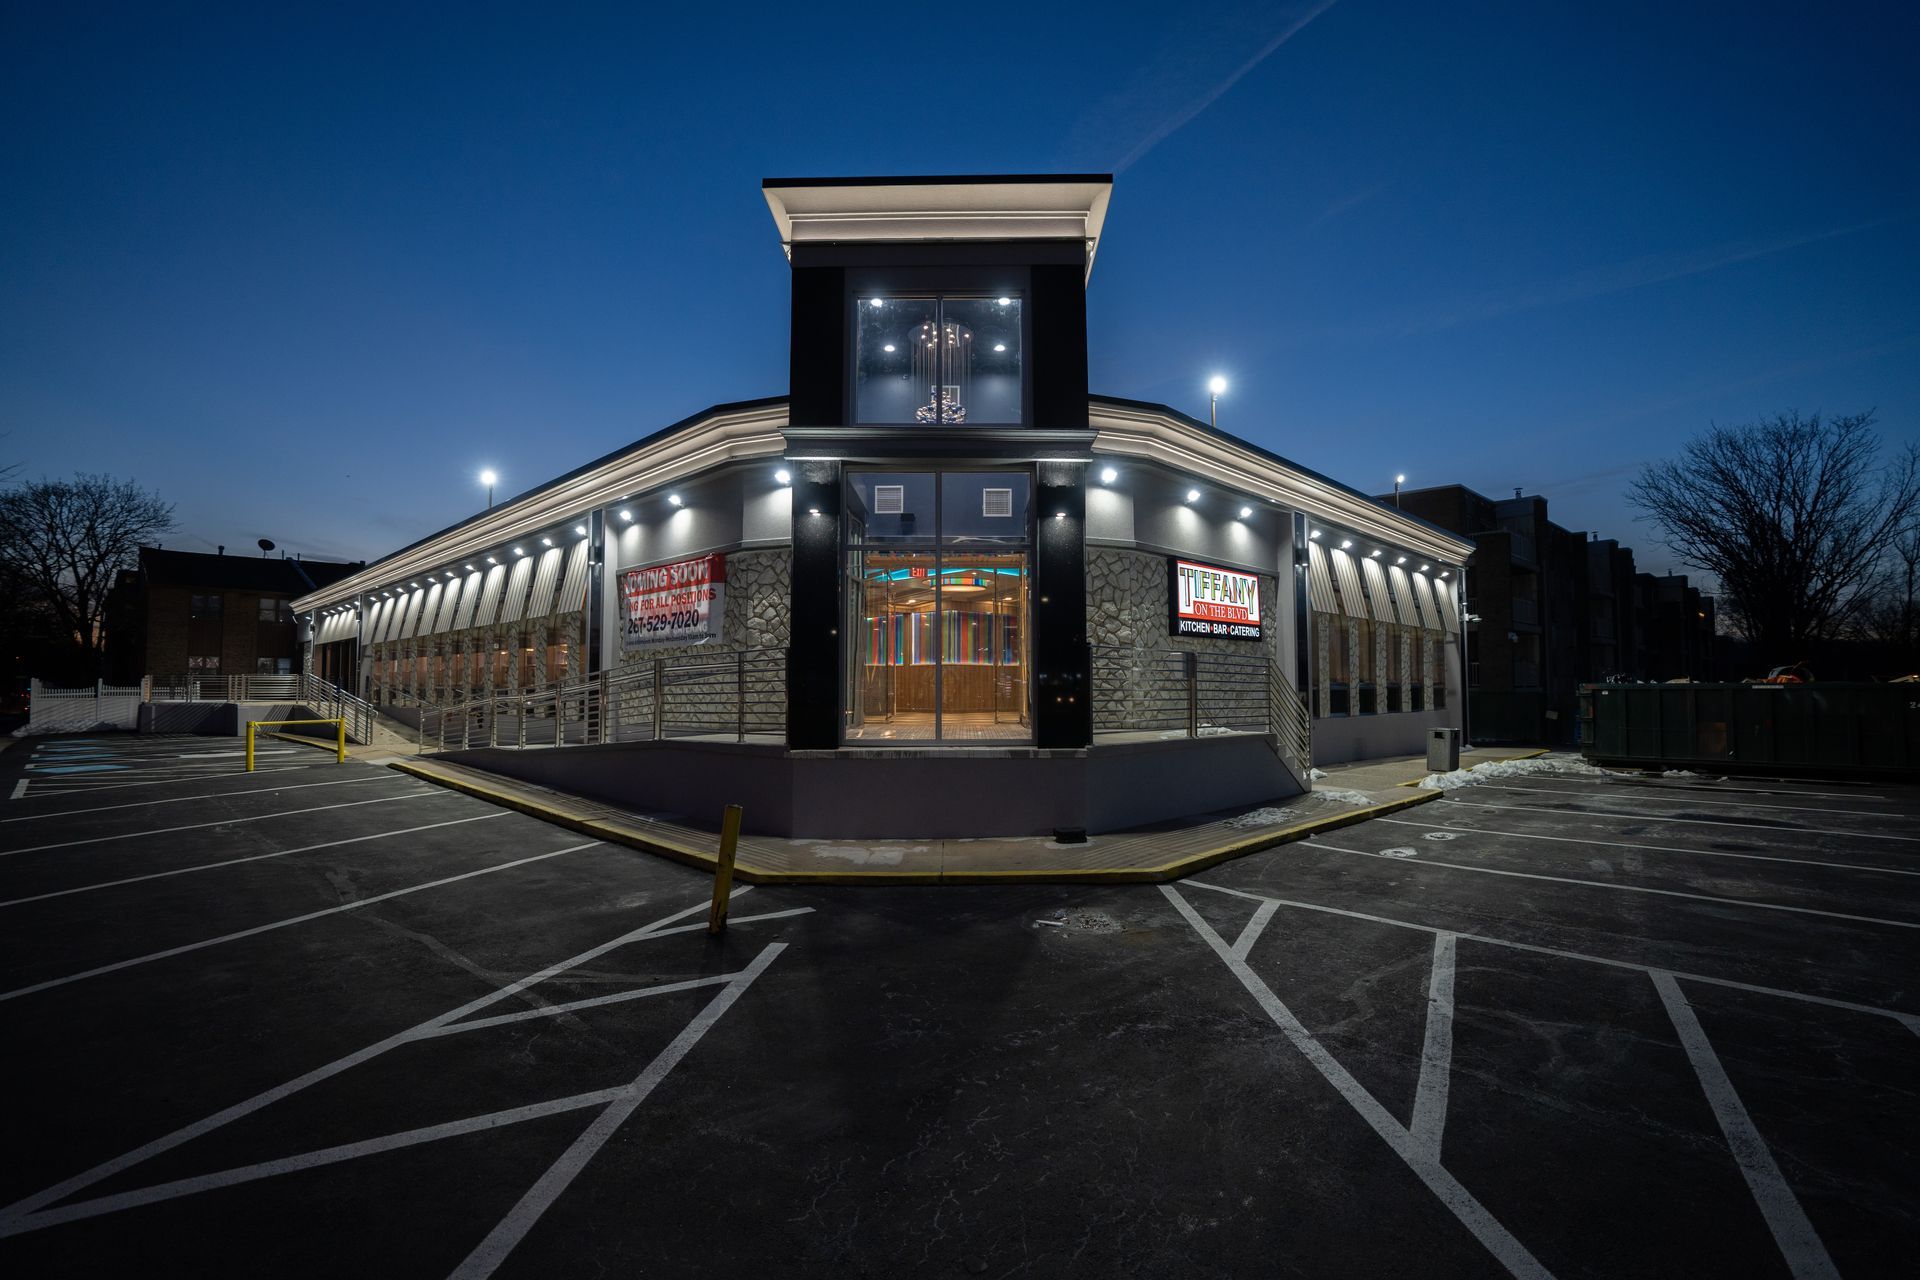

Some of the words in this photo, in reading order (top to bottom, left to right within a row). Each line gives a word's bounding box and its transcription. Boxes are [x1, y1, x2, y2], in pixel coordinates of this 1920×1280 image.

[670, 560, 709, 585] SOON
[912, 568, 925, 577] EXIT
[641, 600, 654, 611] FOR
[656, 597, 669, 608] ALL
[671, 588, 717, 605] POSITIONS
[1180, 567, 1257, 615] TIFFANY
[1194, 603, 1208, 616] ON
[1209, 605, 1226, 618] THE
[1227, 607, 1247, 620] BLVD
[1180, 620, 1211, 633] KITCHEN
[1213, 623, 1227, 635] BAR
[1230, 625, 1260, 637] CATERING
